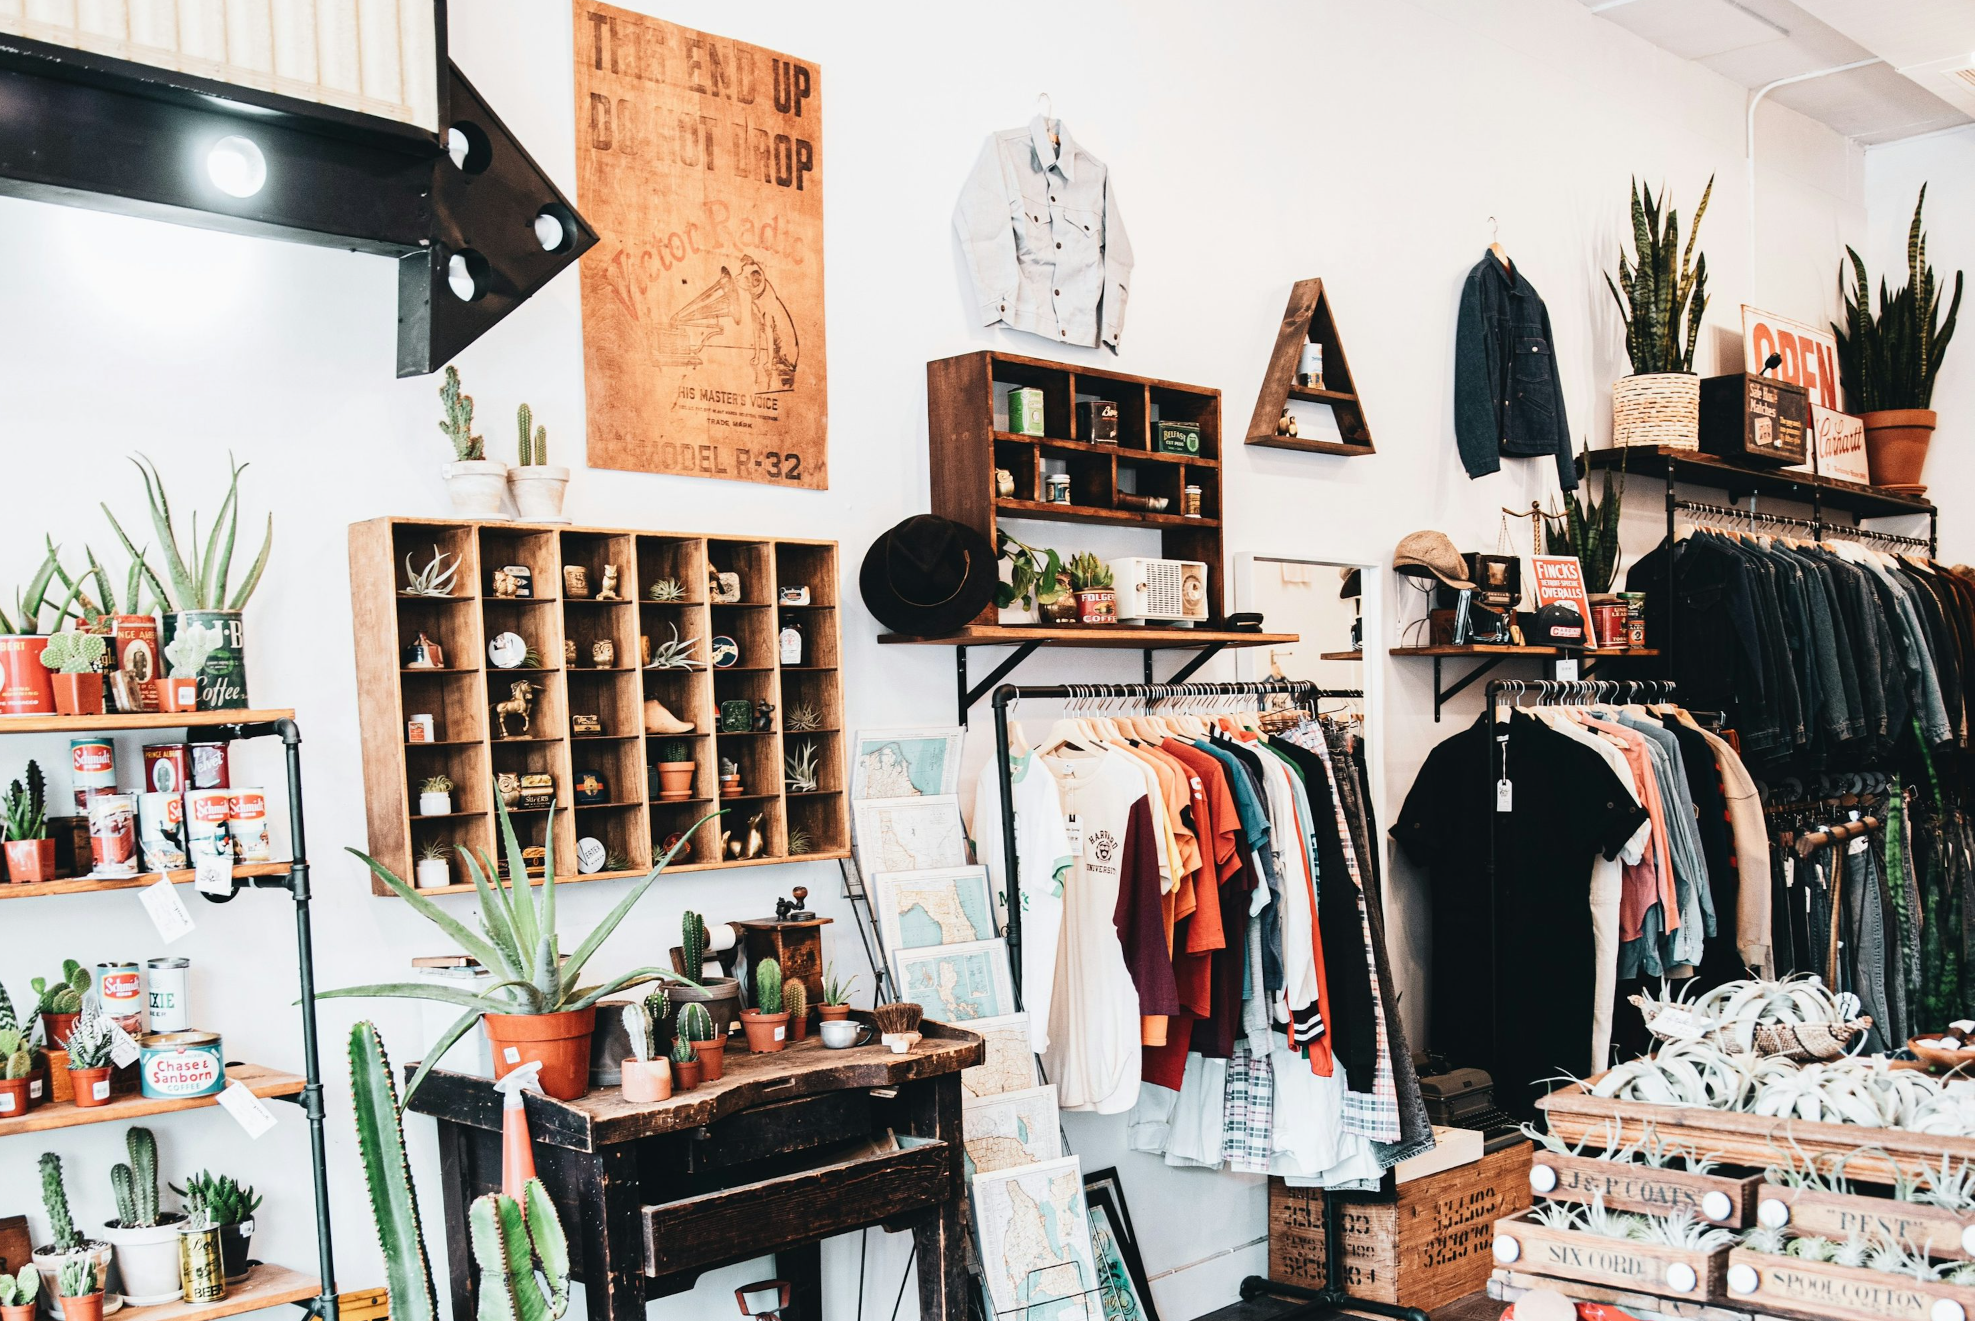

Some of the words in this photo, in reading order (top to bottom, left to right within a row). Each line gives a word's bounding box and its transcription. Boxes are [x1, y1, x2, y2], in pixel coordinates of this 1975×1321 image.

[684, 36, 755, 105] END
[772, 58, 811, 117] UP
[590, 92, 638, 156] DO
[654, 105, 718, 171] NOT
[731, 122, 813, 191] DROP
[1753, 322, 1836, 410] OPEN
[678, 386, 695, 400] HIS
[699, 388, 746, 406] MASTER'S
[749, 394, 778, 411] VOICE
[1163, 430, 1186, 442] BELFAST
[1816, 417, 1862, 459] Carhartt
[639, 440, 727, 474] MODEL
[736, 447, 803, 480] R-32
[1536, 561, 1578, 580] FINCK'S
[1541, 586, 1583, 600] OVERALLS
[0, 641, 26, 652] BERT
[195, 675, 240, 707] Coffee
[73, 746, 112, 767] Schmidt
[229, 797, 265, 817] Schmidt
[1088, 830, 1118, 850] HARVARD
[157, 1060, 199, 1072] Chase
[153, 1071, 212, 1084] Sanborn
[168, 1082, 201, 1092] COFFEE
[1626, 1180, 1698, 1207] COATS
[1548, 1244, 1583, 1268] SIX
[1588, 1250, 1642, 1276] CORD
[194, 1284, 223, 1299] BEER
[1772, 1271, 1838, 1295] SPOOL
[1841, 1282, 1925, 1311] COTTON
